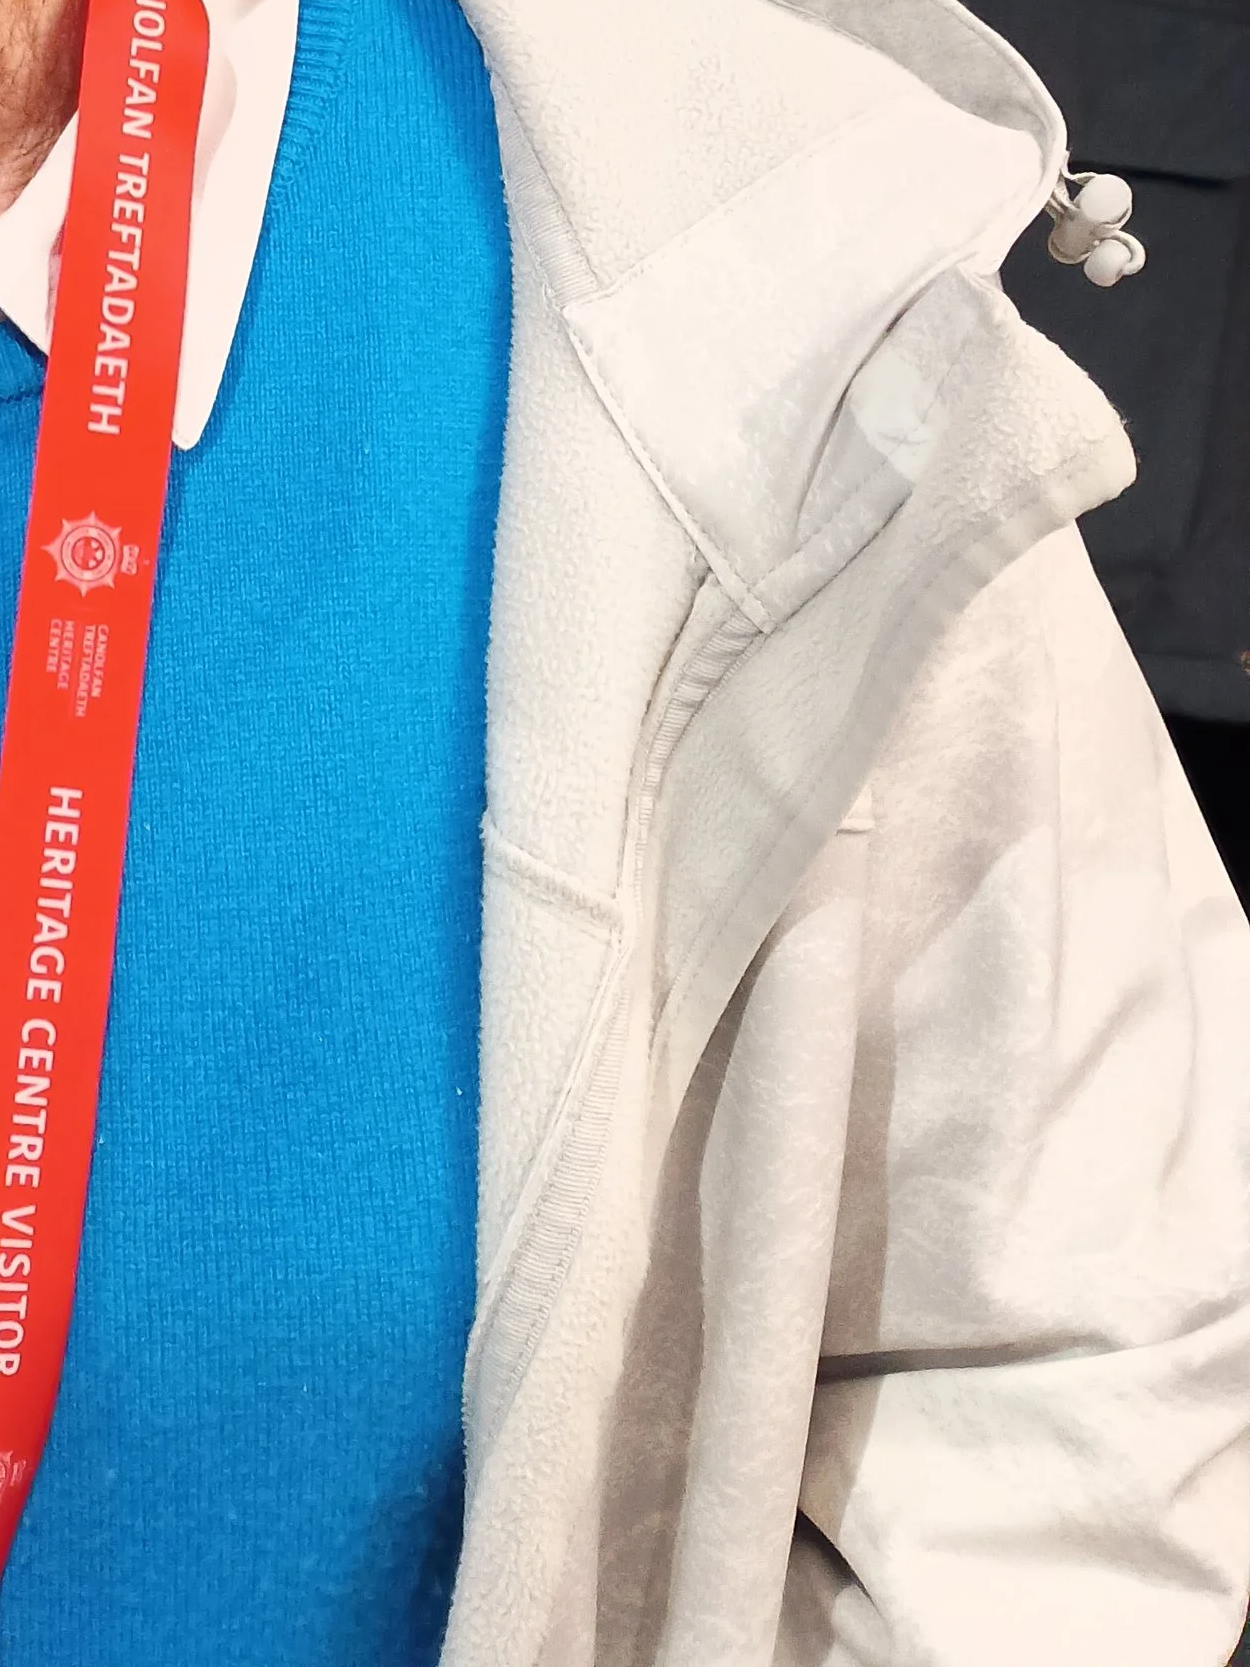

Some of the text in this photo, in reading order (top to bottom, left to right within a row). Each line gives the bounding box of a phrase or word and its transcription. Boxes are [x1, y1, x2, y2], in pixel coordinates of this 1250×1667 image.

[86, 151, 152, 435] TREFTADAETH
[45, 617, 62, 673] CENTRE
[57, 619, 75, 690] HERITAGE
[25, 786, 84, 1004] HERITAGE
[4, 1016, 57, 1189] CENTRE
